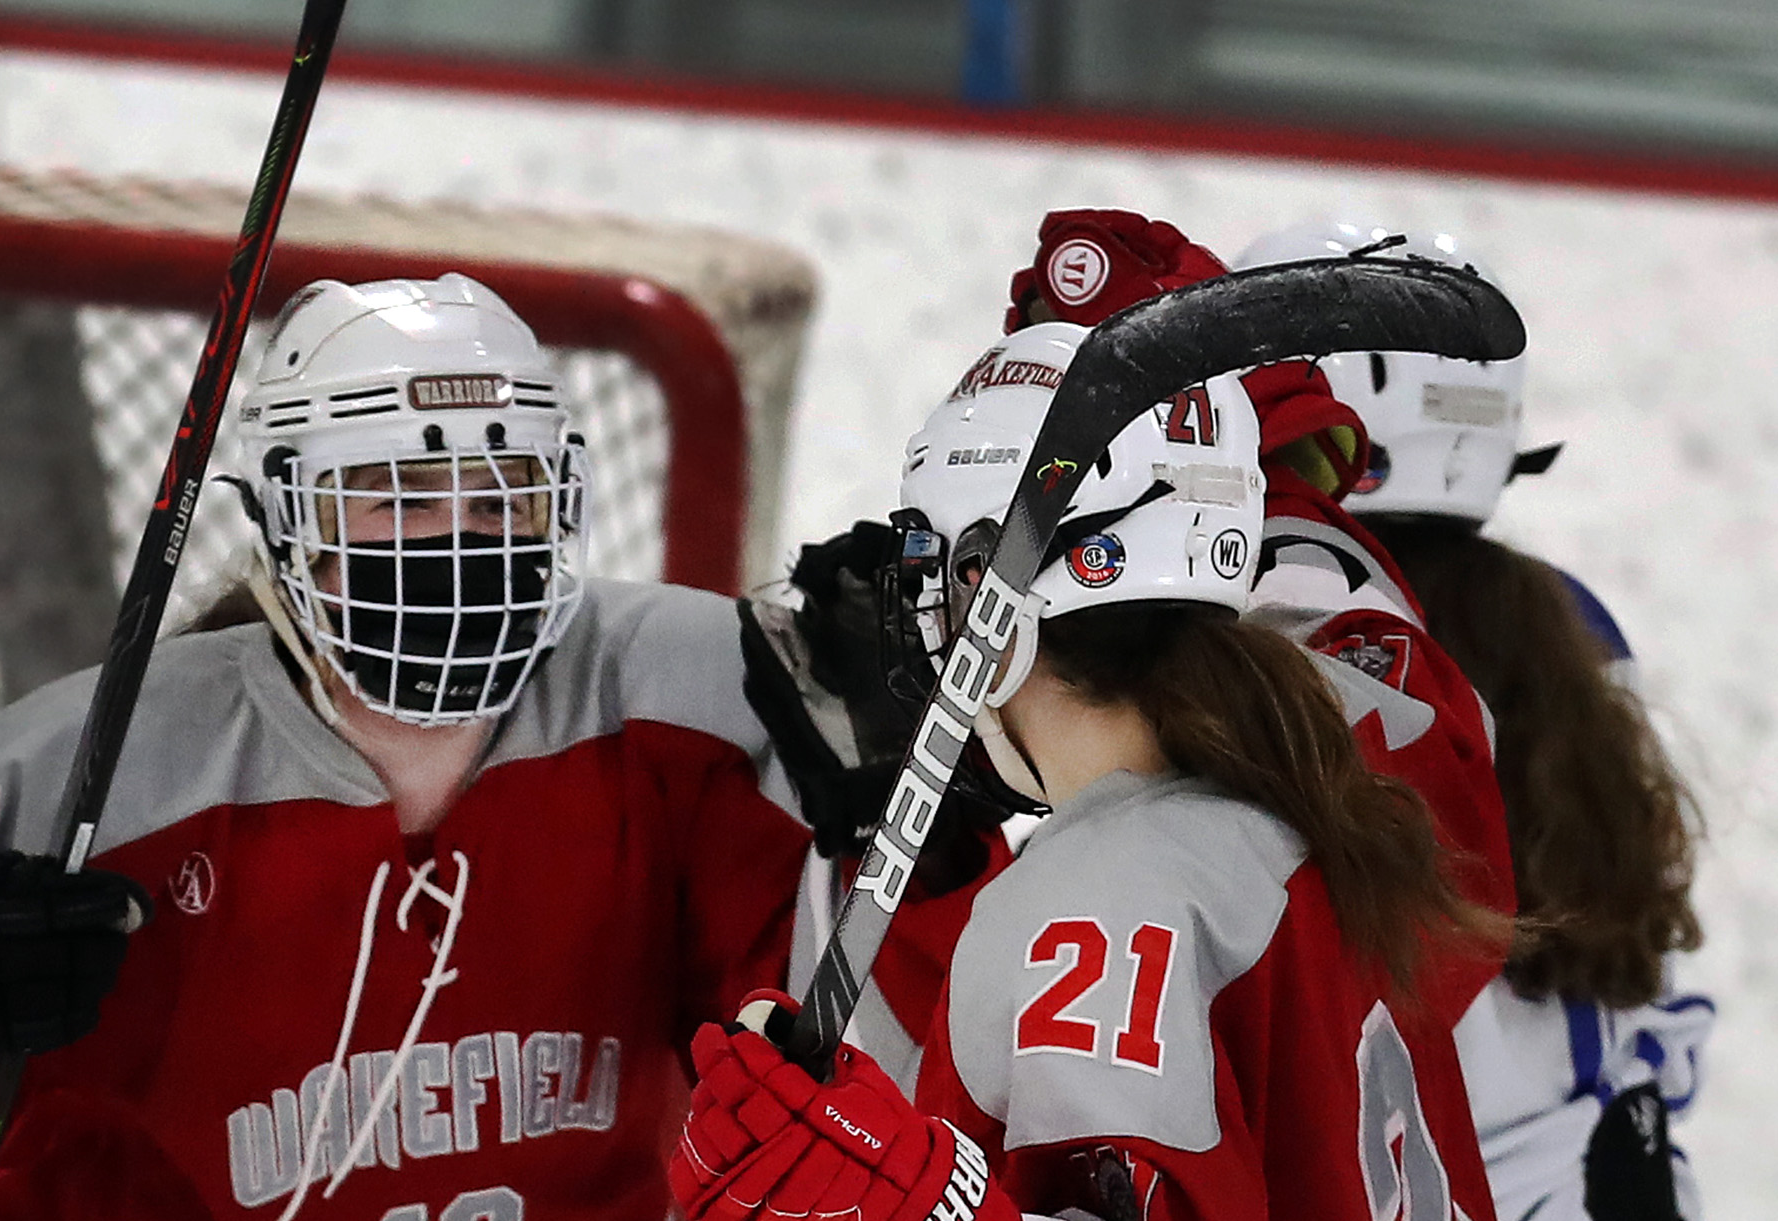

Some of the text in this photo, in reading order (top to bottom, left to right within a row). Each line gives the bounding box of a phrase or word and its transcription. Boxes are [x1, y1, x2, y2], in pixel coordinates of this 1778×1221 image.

[1165, 387, 1215, 447] 21
[946, 448, 1021, 466] BAUER
[163, 478, 199, 566] BAUER
[1220, 539, 1240, 568] WL
[855, 586, 1019, 914] BAUER
[1015, 916, 1179, 1075] 21
[227, 1031, 621, 1208] WAKEFIELD
[825, 1104, 882, 1150] ALPHA
